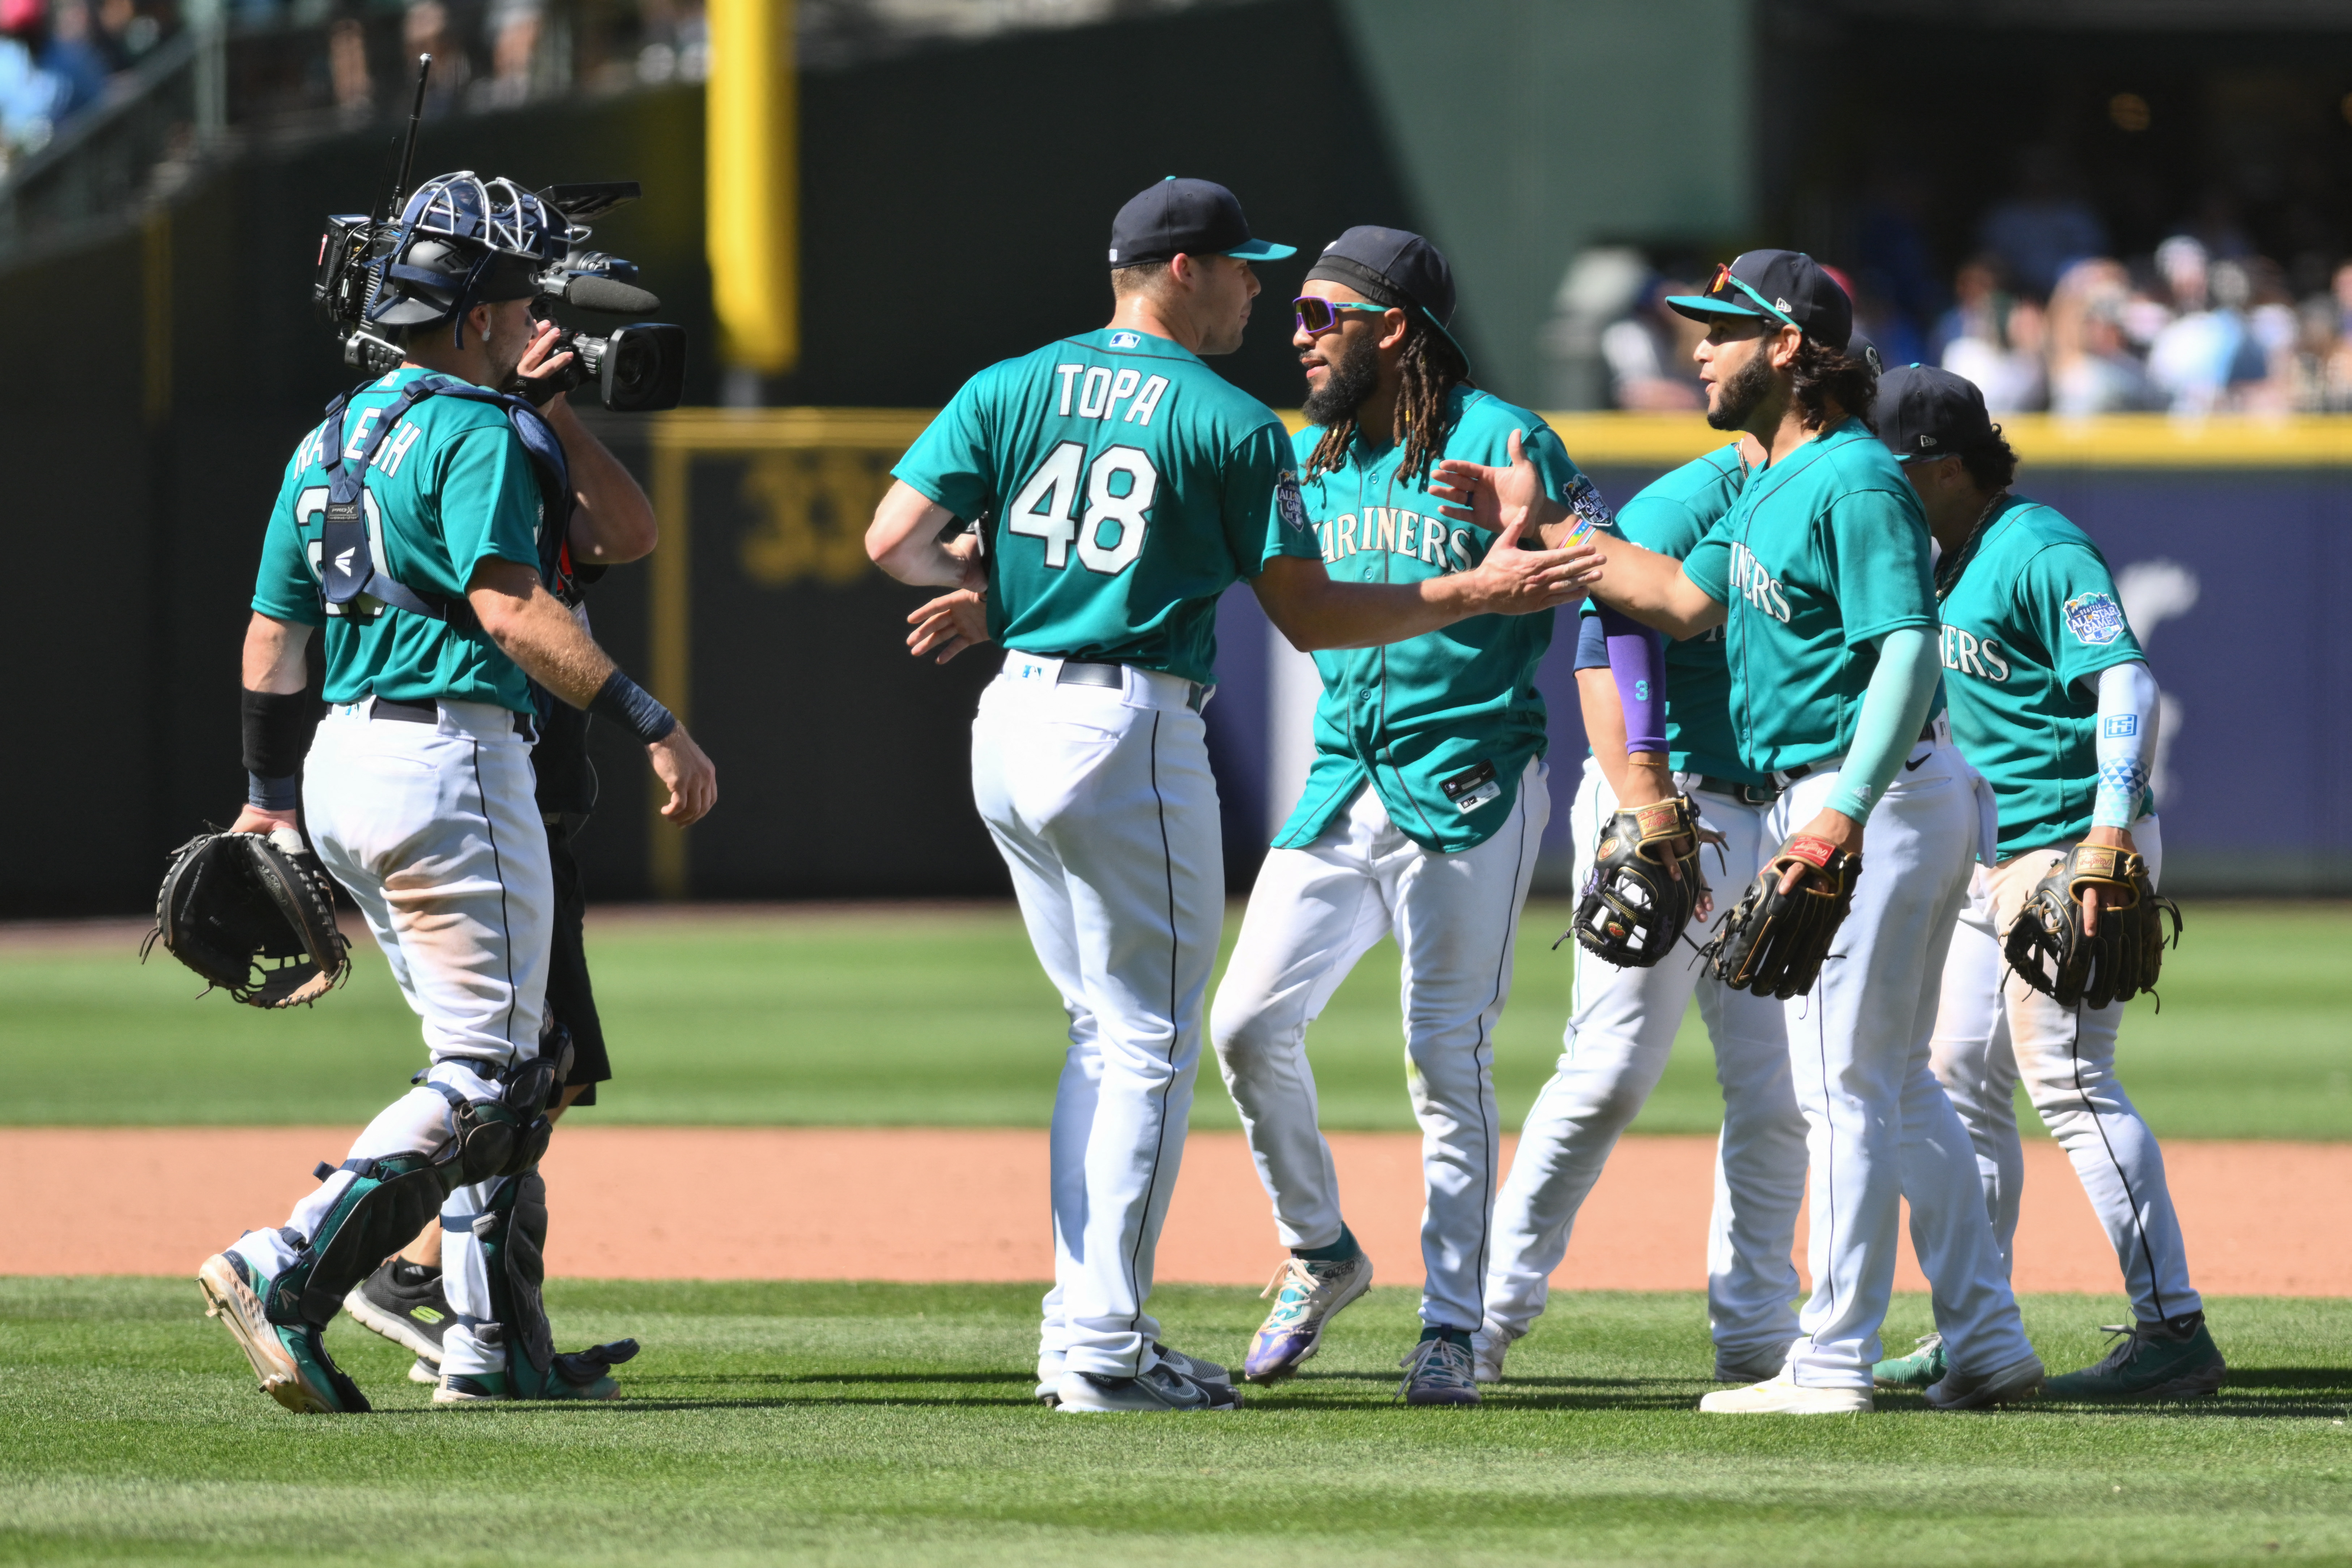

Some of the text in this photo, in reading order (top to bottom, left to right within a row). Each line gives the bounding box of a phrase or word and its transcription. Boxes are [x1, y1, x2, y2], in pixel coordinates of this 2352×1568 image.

[1057, 363, 1170, 427] TOPA
[1008, 440, 1160, 576] 48
[1311, 506, 1473, 572] ARINERS
[2071, 614, 2093, 631] ALL
[2091, 606, 2118, 621] STAR
[2079, 603, 2102, 615] SEATTLE
[2083, 616, 2114, 634] GAME
[1635, 680, 1648, 700] 3
[1322, 1260, 1355, 1279] ADIZERO
[1090, 1372, 1112, 1383] TROUT
